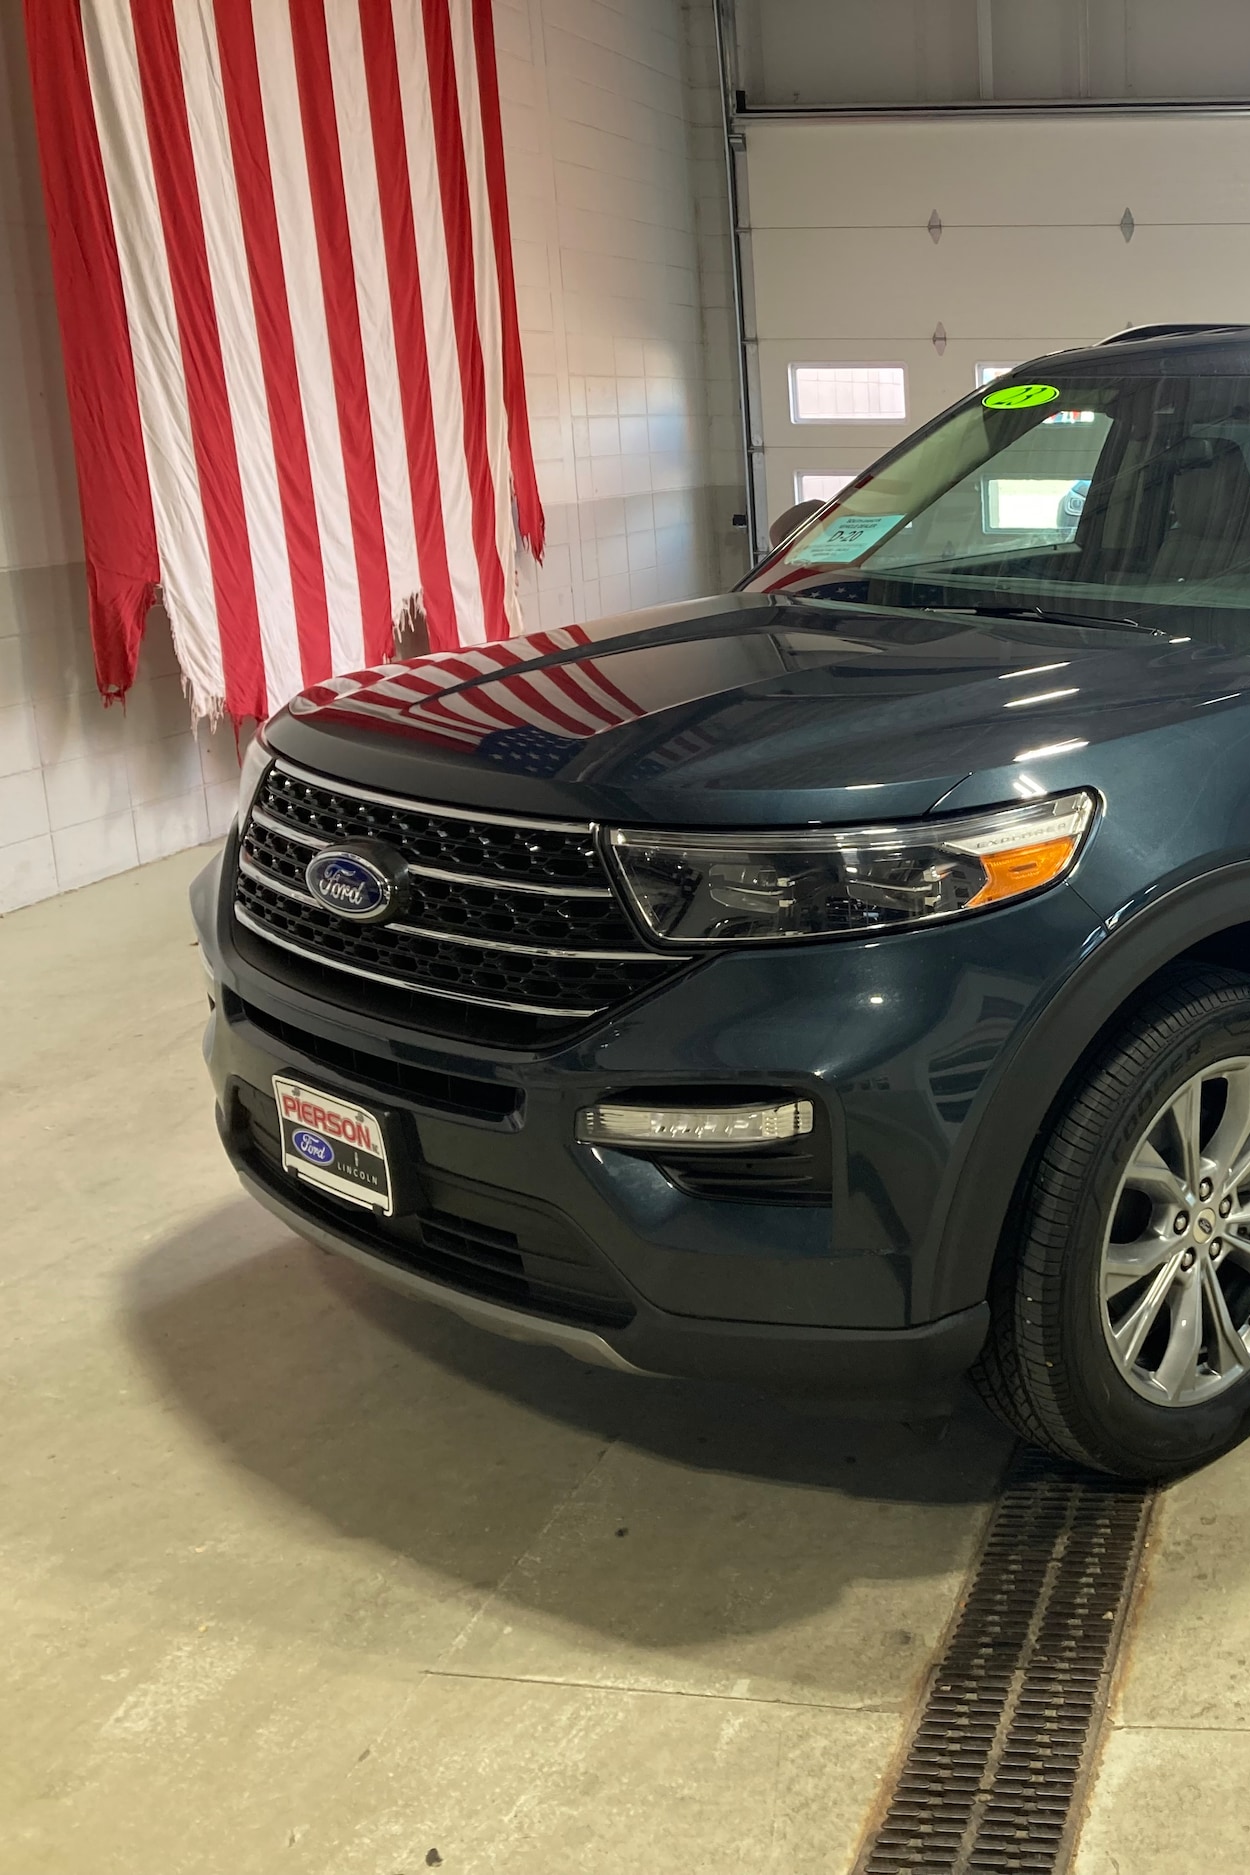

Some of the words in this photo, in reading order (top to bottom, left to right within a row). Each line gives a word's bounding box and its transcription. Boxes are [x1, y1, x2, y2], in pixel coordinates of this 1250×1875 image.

[827, 530, 864, 542] D-20
[319, 863, 366, 905] Ford
[282, 1093, 372, 1150] PIERSON
[300, 1133, 326, 1160] Ford
[336, 1161, 379, 1185] LINCOLN
